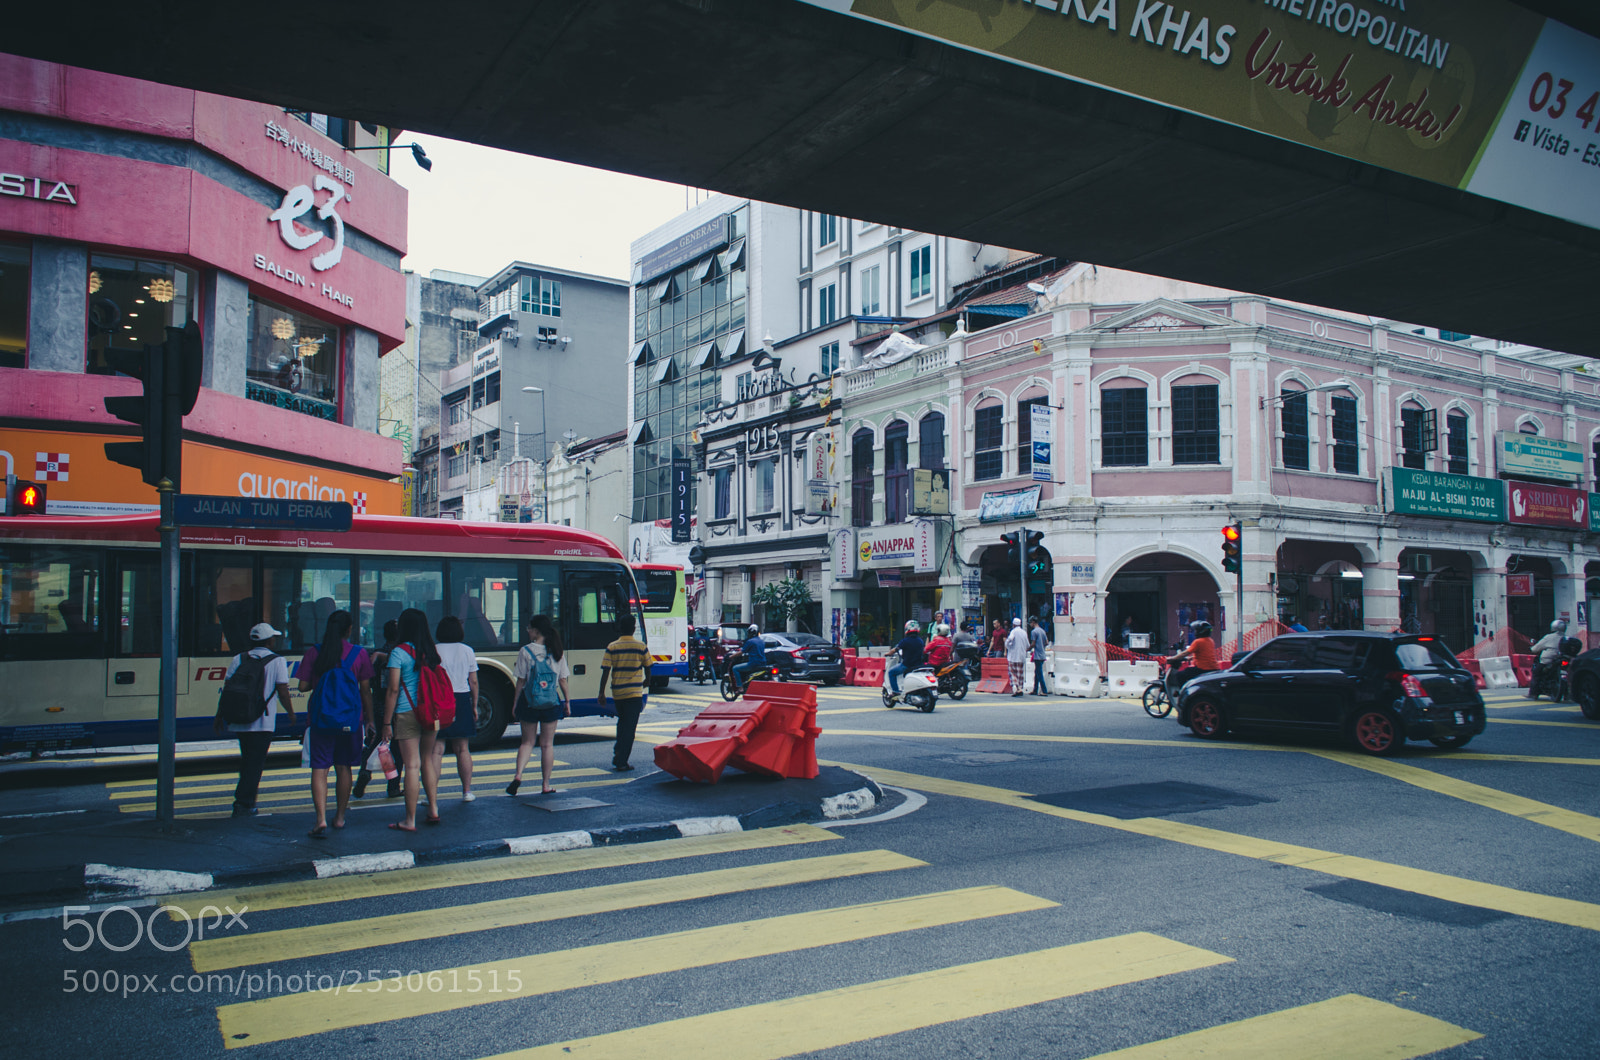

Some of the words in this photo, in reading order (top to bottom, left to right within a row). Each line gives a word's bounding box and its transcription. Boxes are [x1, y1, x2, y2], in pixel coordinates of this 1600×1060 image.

[1129, 0, 1237, 65] KHAS
[1244, 27, 1355, 109] Untuk
[1351, 73, 1463, 143] Anda!
[1529, 72, 1575, 119] 03
[1576, 91, 1600, 133] 4
[1533, 125, 1571, 156] Vista
[1581, 143, 1600, 168] Es
[254, 254, 305, 287] SALON
[321, 283, 354, 309] HAIR
[249, 388, 277, 407] HAIR
[283, 397, 323, 419] SALON
[745, 423, 780, 454] 1915
[1412, 473, 1430, 486] KEDAI
[1434, 476, 1471, 490] BARANGAN
[1475, 482, 1485, 491] AM
[193, 501, 241, 515] JALAN
[250, 503, 280, 517] TUN
[288, 505, 333, 519] PERAK
[678, 471, 686, 525] 1915
[1403, 488, 1425, 501] MAJU
[1431, 491, 1466, 506] AL-BISMI
[1471, 496, 1495, 508] STORE
[1529, 491, 1569, 507] SRIDEVI
[554, 548, 582, 556] rapidKL
[872, 537, 914, 555] ANJAPPAR
